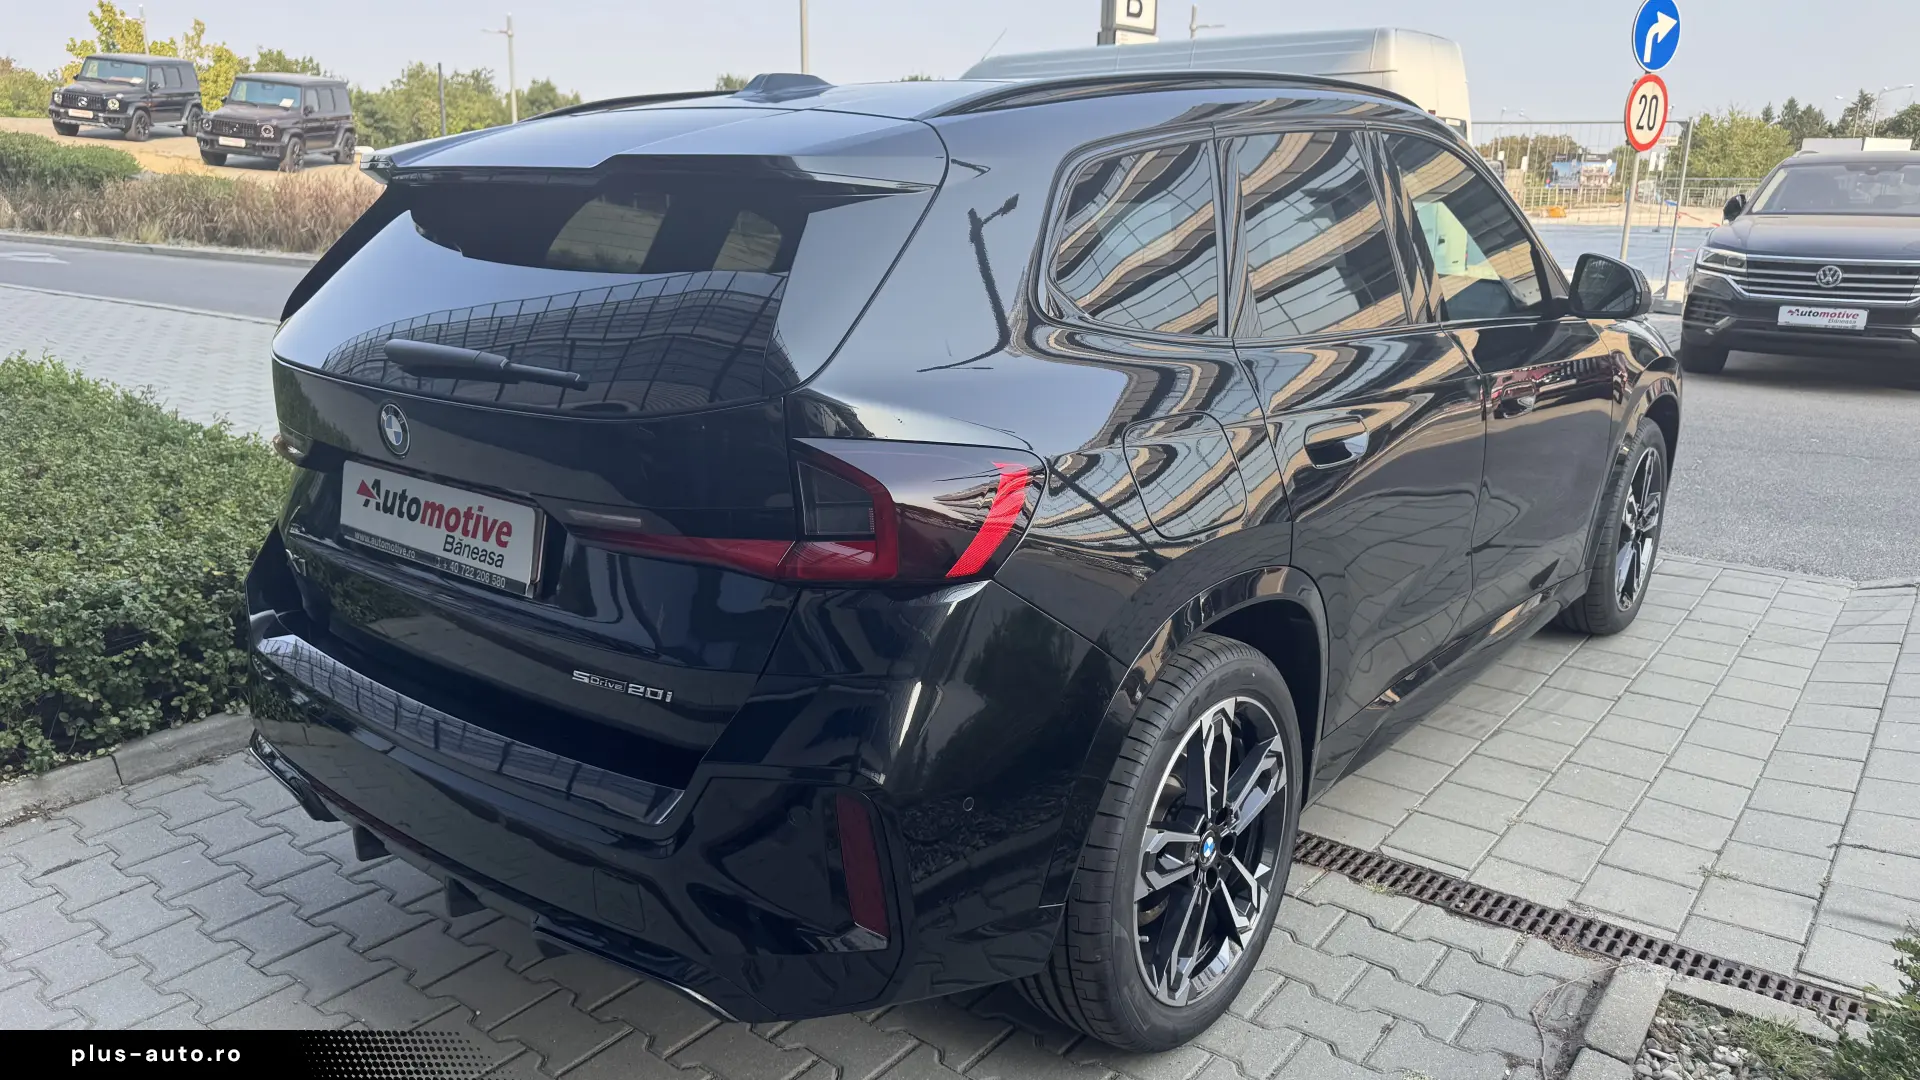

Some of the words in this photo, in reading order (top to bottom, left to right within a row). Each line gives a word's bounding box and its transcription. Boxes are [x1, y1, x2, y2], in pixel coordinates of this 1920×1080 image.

[1636, 94, 1659, 131] 20
[1787, 308, 1860, 320] Automotive
[357, 478, 513, 549] Automotive
[354, 531, 416, 559] www.automotive.ro
[442, 533, 505, 569] Băneasa
[461, 564, 475, 578] 722
[476, 569, 490, 583] 206
[492, 574, 506, 589] 580
